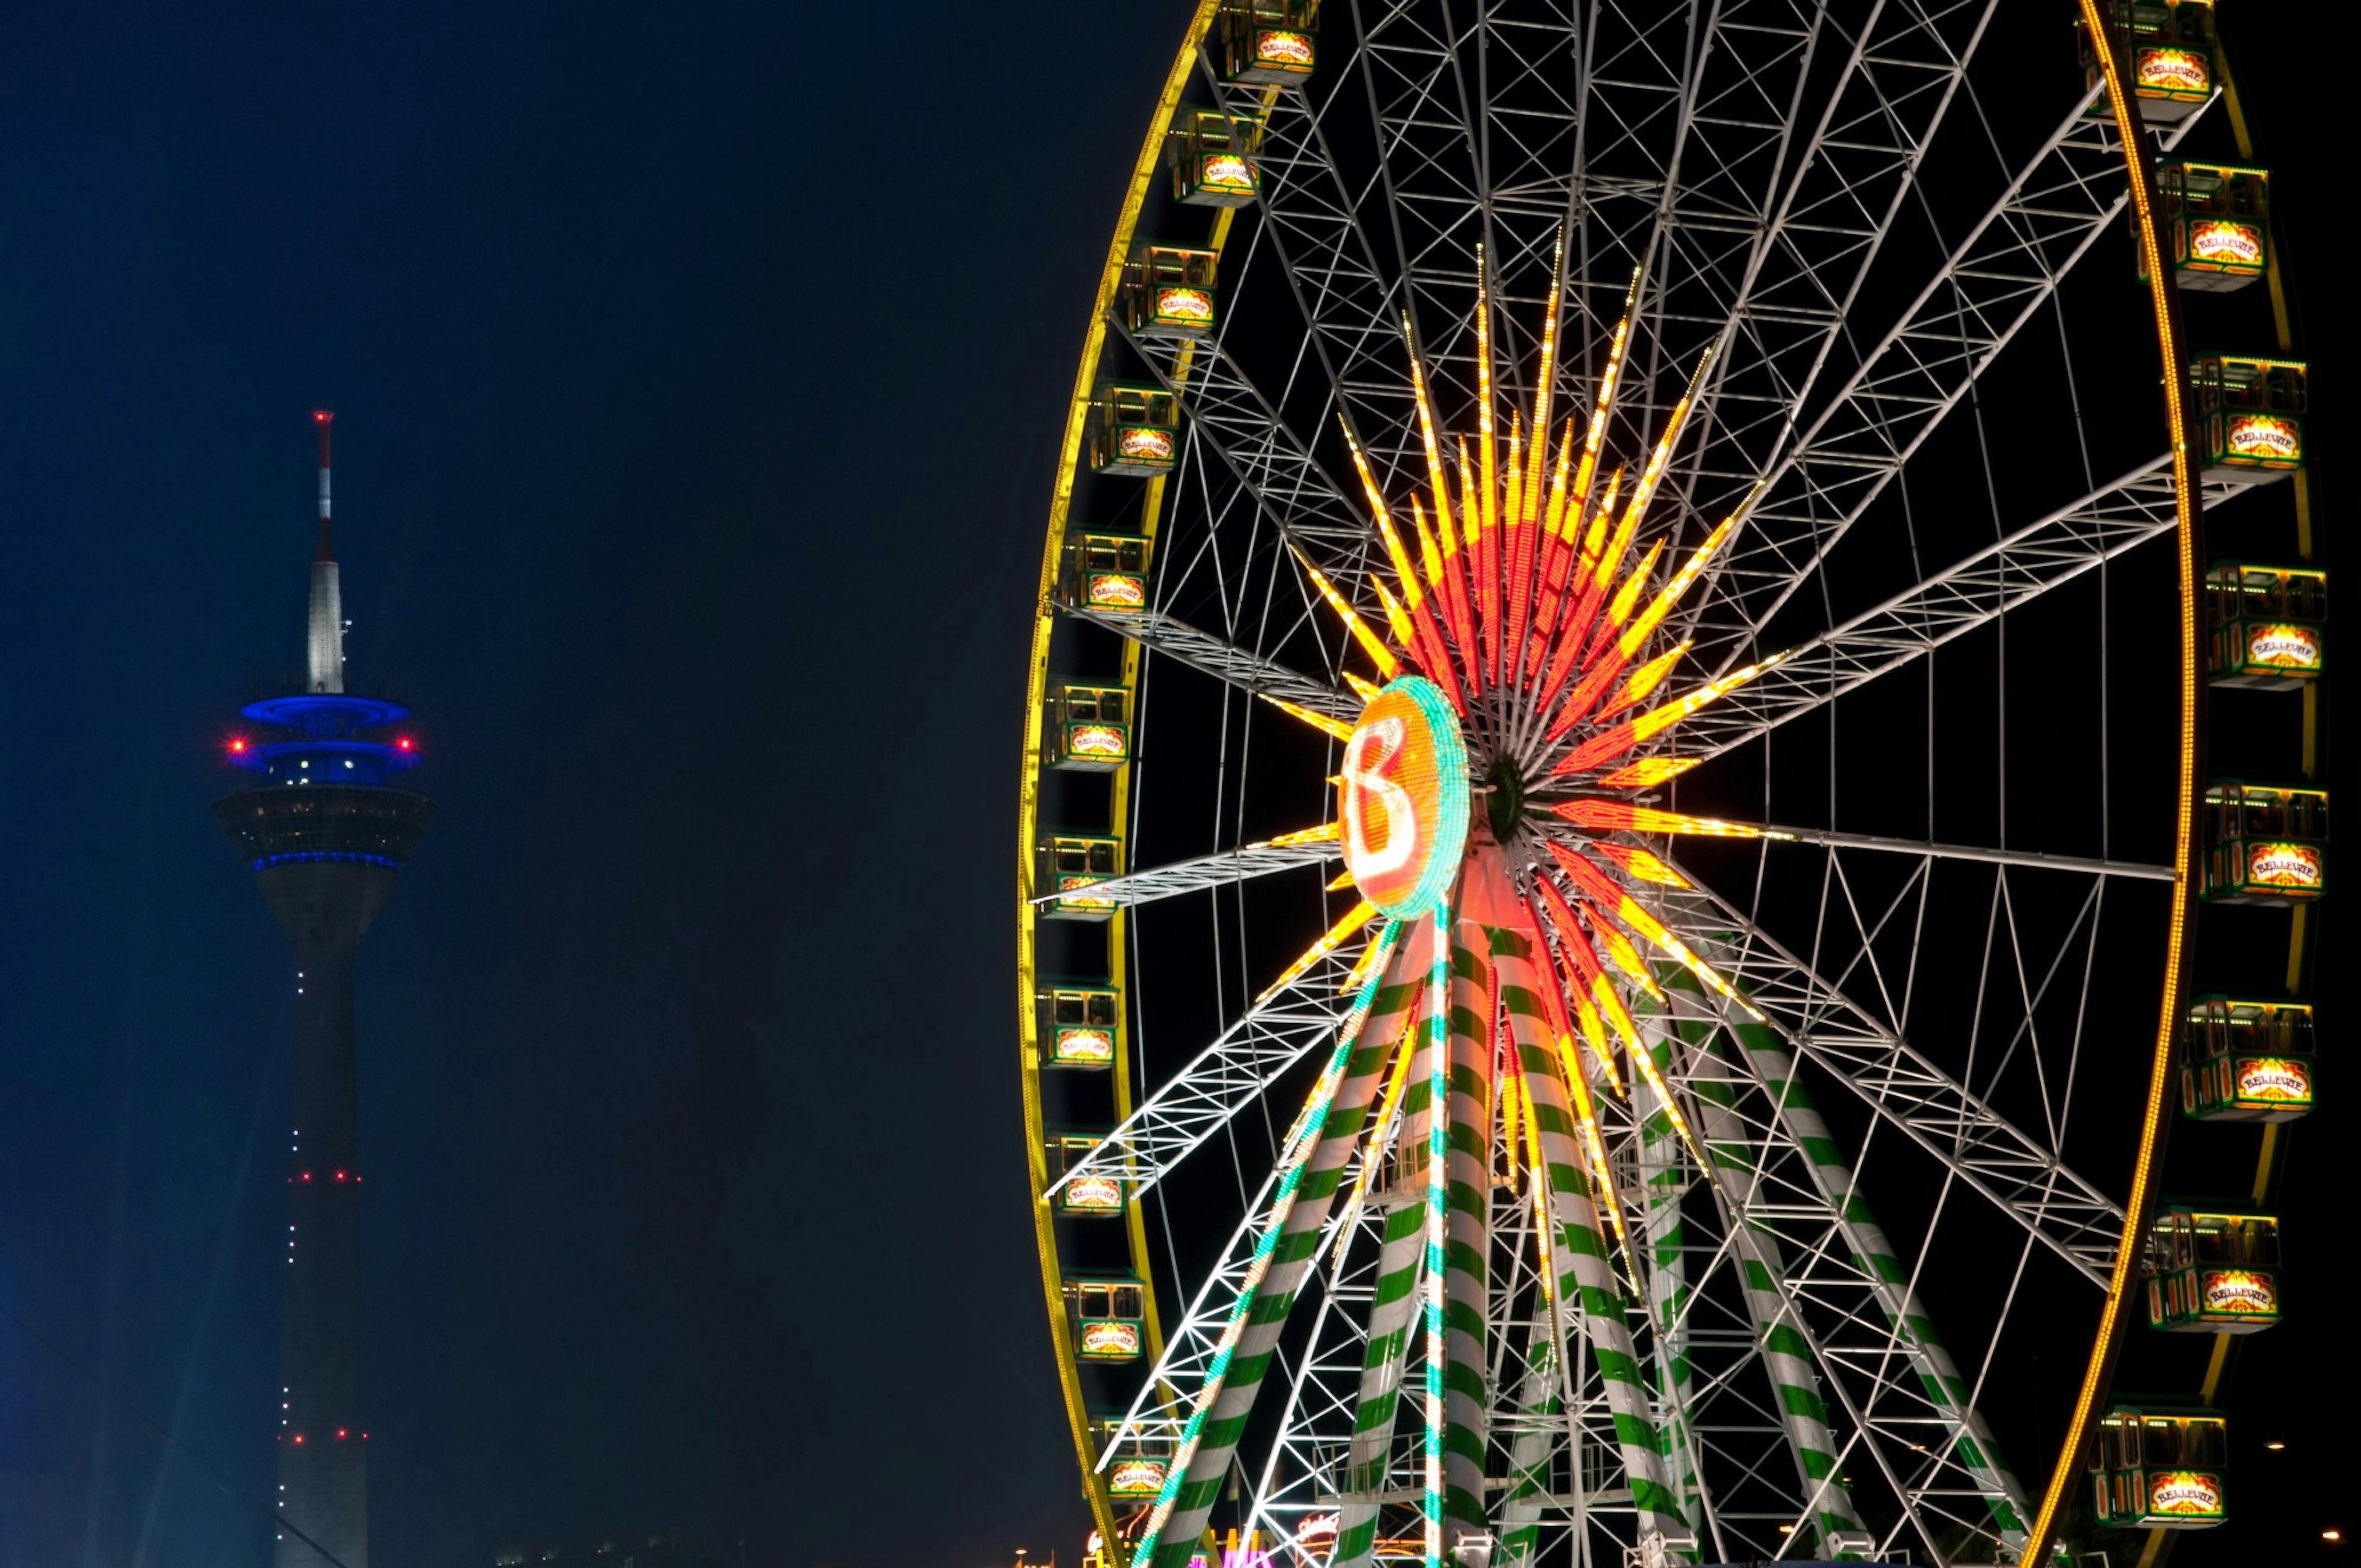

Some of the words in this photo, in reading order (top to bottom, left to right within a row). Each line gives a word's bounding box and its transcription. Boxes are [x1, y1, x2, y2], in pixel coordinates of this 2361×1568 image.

[1264, 44, 1307, 57] BELLEVUE
[2146, 65, 2201, 82] BELLEVUE
[1209, 168, 1248, 178] BELLEVU
[2199, 237, 2254, 255] BELLEVUE
[1163, 301, 1206, 313] BELLEVUE
[1125, 441, 1168, 453] BELLEVUE
[2236, 432, 2292, 449] BELLEVUE
[1096, 587, 1138, 598] BELLEVUE
[2256, 641, 2312, 659] BELLEVUE
[1077, 738, 1118, 750] BELLEVUE
[2258, 860, 2314, 877] BELLEVUE
[2245, 1075, 2303, 1092] BELLEVUE
[1073, 1190, 1115, 1200] BELLEVUE
[2211, 1288, 2268, 1304] BELLEVUE
[1089, 1336, 1132, 1346] BELLEVUE
[1118, 1473, 1160, 1484] BELLEVUE
[2157, 1489, 2215, 1505] BELLEVUE
